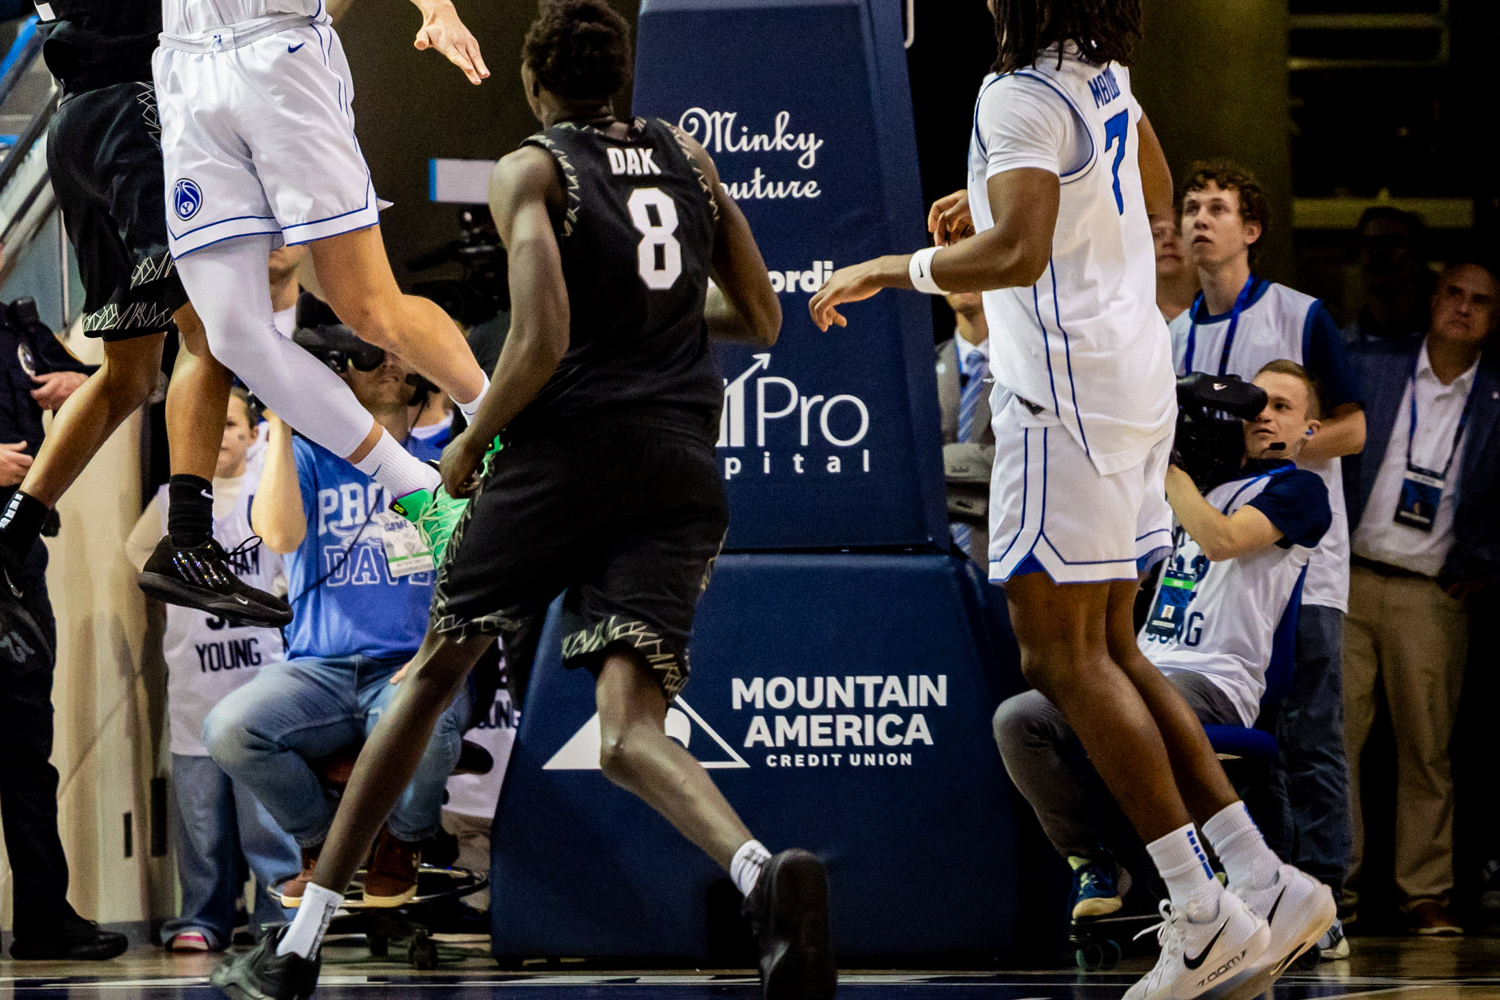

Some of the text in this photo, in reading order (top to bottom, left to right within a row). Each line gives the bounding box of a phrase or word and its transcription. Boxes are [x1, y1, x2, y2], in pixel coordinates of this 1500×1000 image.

[678, 107, 823, 169] Minky
[607, 147, 661, 175] DAK
[1104, 108, 1128, 216] 7
[628, 187, 682, 290] 8
[196, 638, 262, 673] YOUNG
[732, 675, 947, 709] MOUNTAIN
[744, 713, 934, 748] AMERICA
[766, 752, 913, 767] CREDIT UNION
